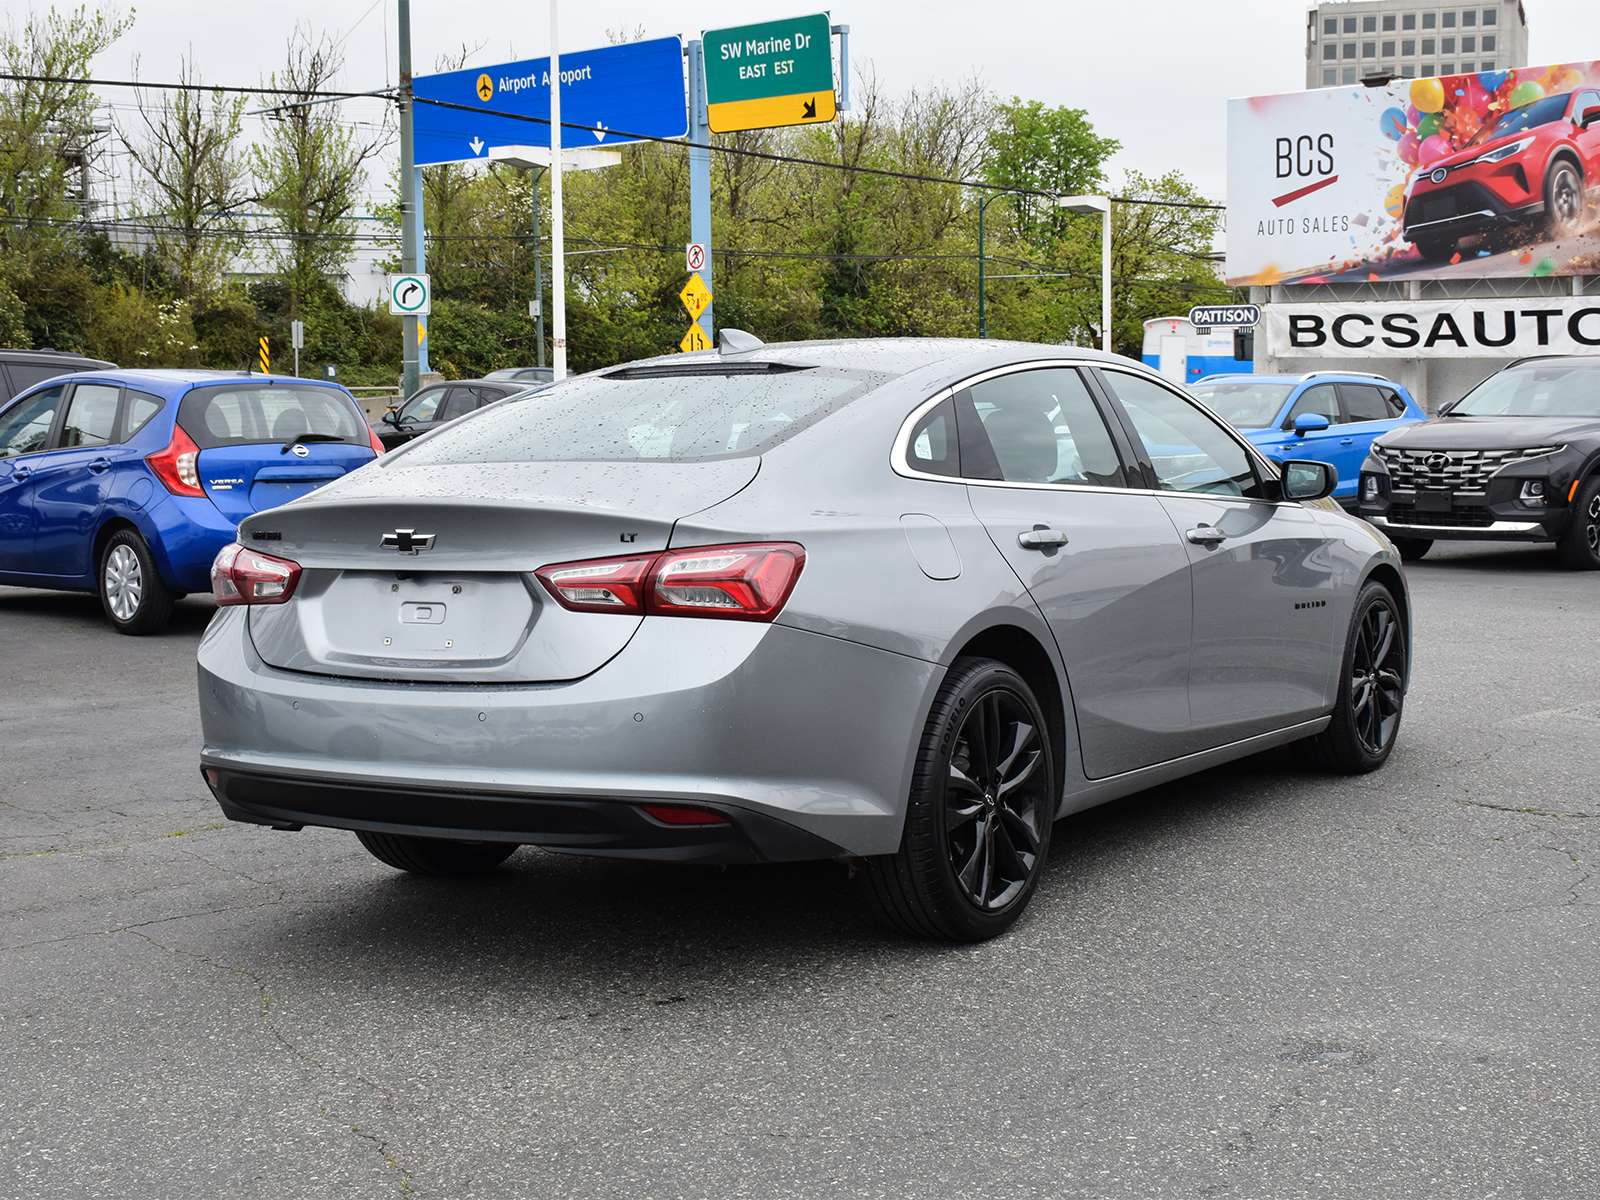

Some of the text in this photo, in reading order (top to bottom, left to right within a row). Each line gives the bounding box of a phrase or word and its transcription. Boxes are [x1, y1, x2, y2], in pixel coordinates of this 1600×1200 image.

[720, 32, 812, 60] SW Marine Dr
[499, 65, 593, 94] Airport Aoport
[739, 60, 795, 79] EAST EST
[1276, 133, 1334, 178] BCS
[1257, 215, 1350, 236] AUTO SALES
[1194, 309, 1255, 323] PATTISON
[620, 532, 639, 543] LT
